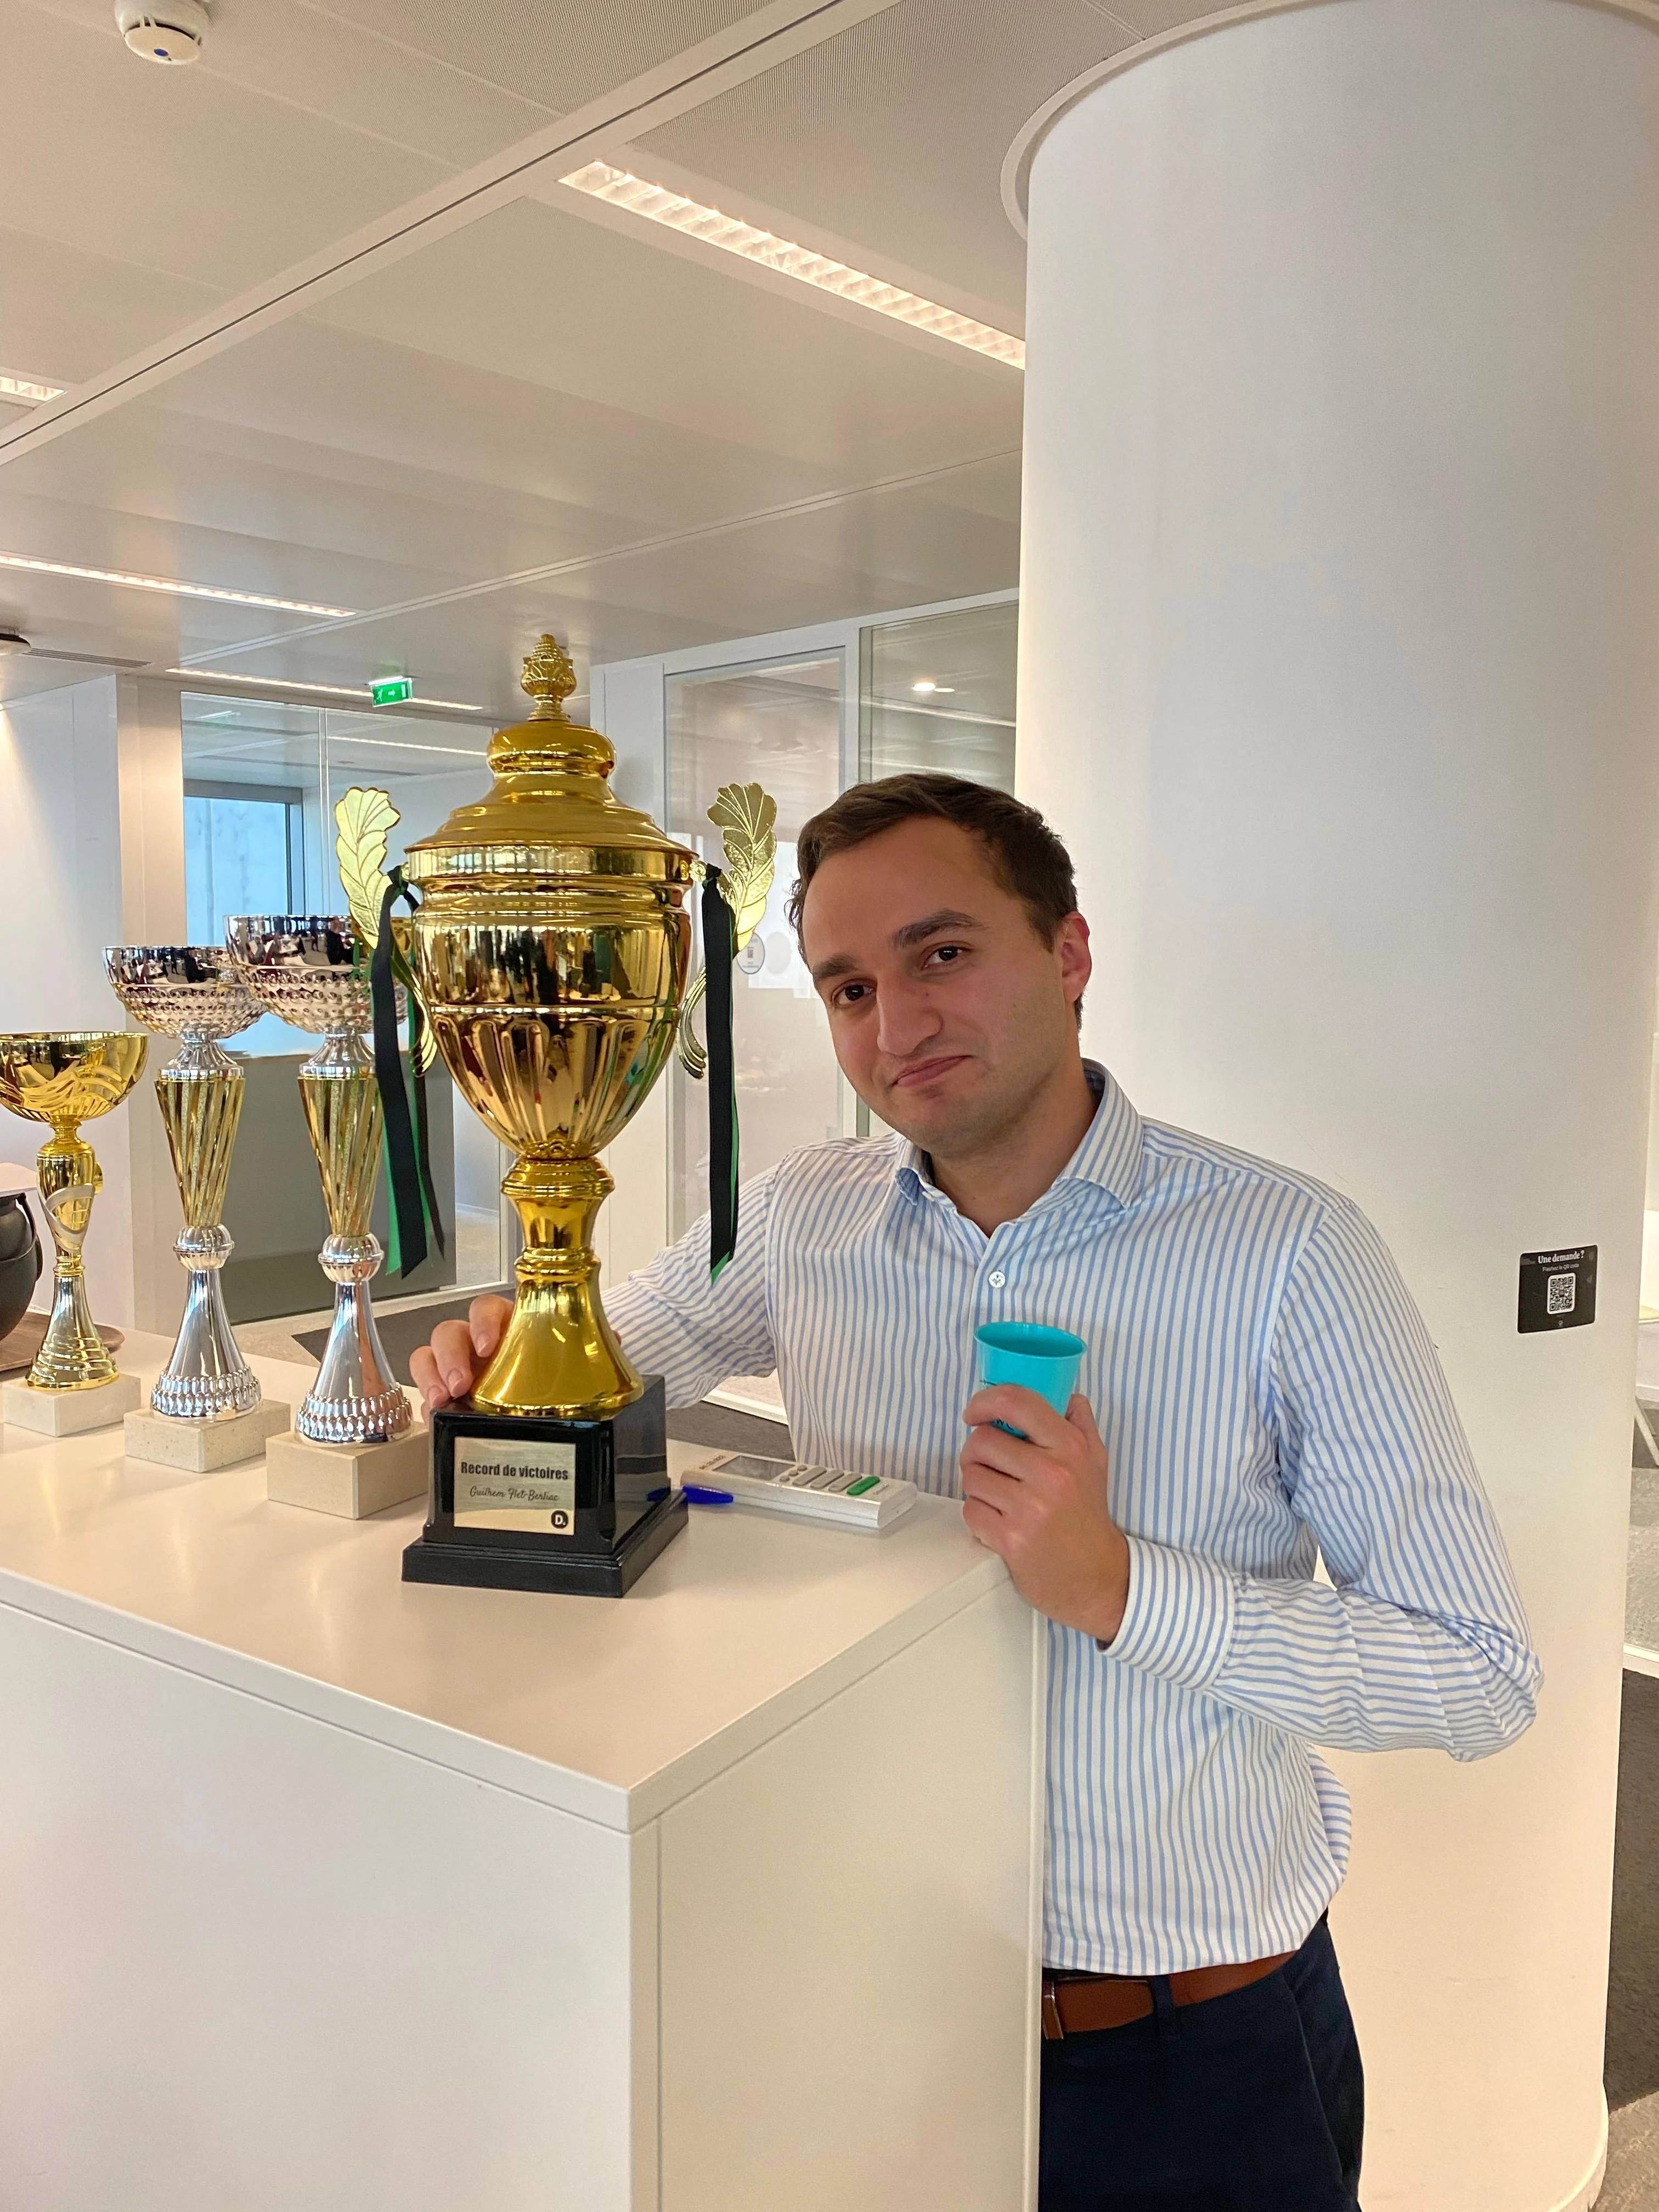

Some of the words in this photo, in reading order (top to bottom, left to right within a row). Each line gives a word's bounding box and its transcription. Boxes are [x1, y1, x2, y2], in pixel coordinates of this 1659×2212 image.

[1538, 1255, 1551, 1263] Une
[1552, 1251, 1580, 1262] demande
[1581, 1250, 1584, 1259] ?
[461, 1462, 500, 1476] Record
[503, 1464, 516, 1476] de
[519, 1466, 568, 1480] victoires
[470, 1486, 505, 1497] Guilhem
